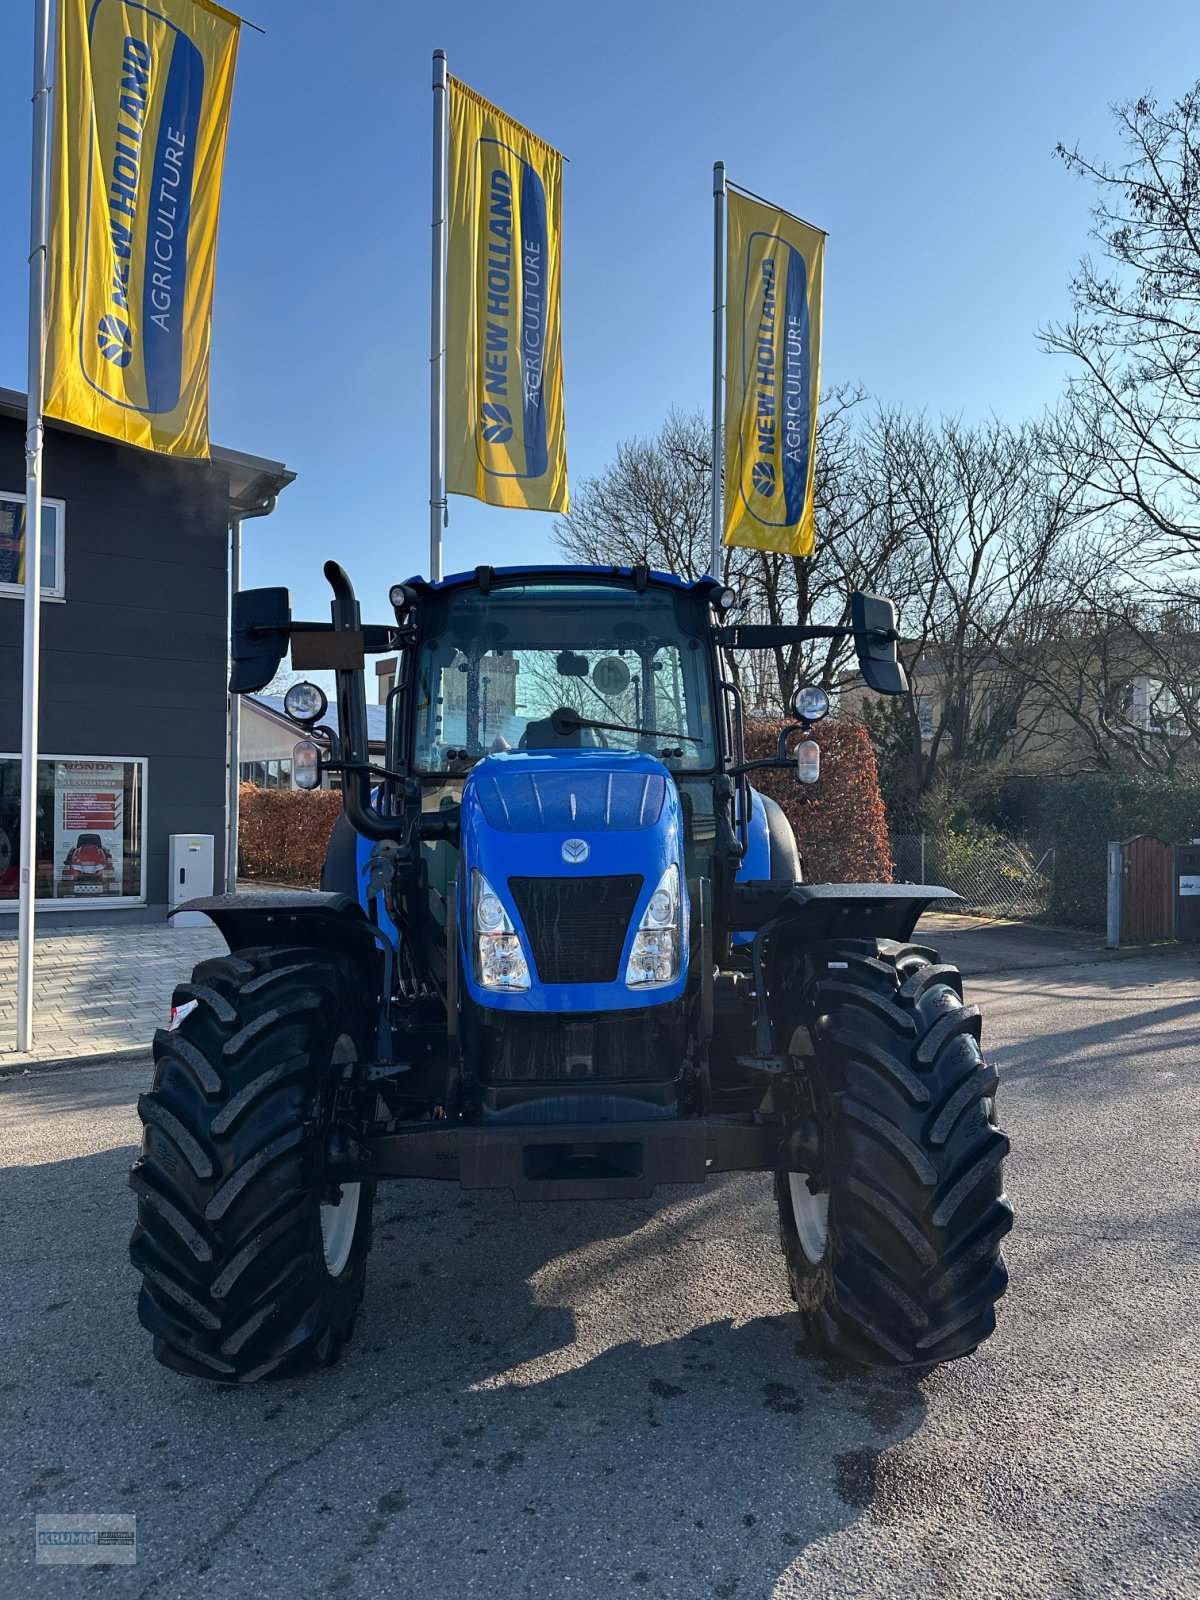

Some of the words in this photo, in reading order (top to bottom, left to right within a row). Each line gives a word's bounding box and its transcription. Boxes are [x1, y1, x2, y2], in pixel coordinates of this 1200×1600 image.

[109, 36, 151, 218] HOLLAND
[110, 216, 133, 310] NEW
[150, 126, 186, 332] AGRICULTURE
[487, 169, 513, 316] HOLLAND
[485, 320, 508, 396] NEW
[525, 239, 541, 408] AGRICULTURE
[757, 258, 776, 386] HOLLAND
[786, 315, 802, 462] AGRICULTURE
[757, 390, 776, 456] NEW
[64, 763, 115, 771] HONDA
